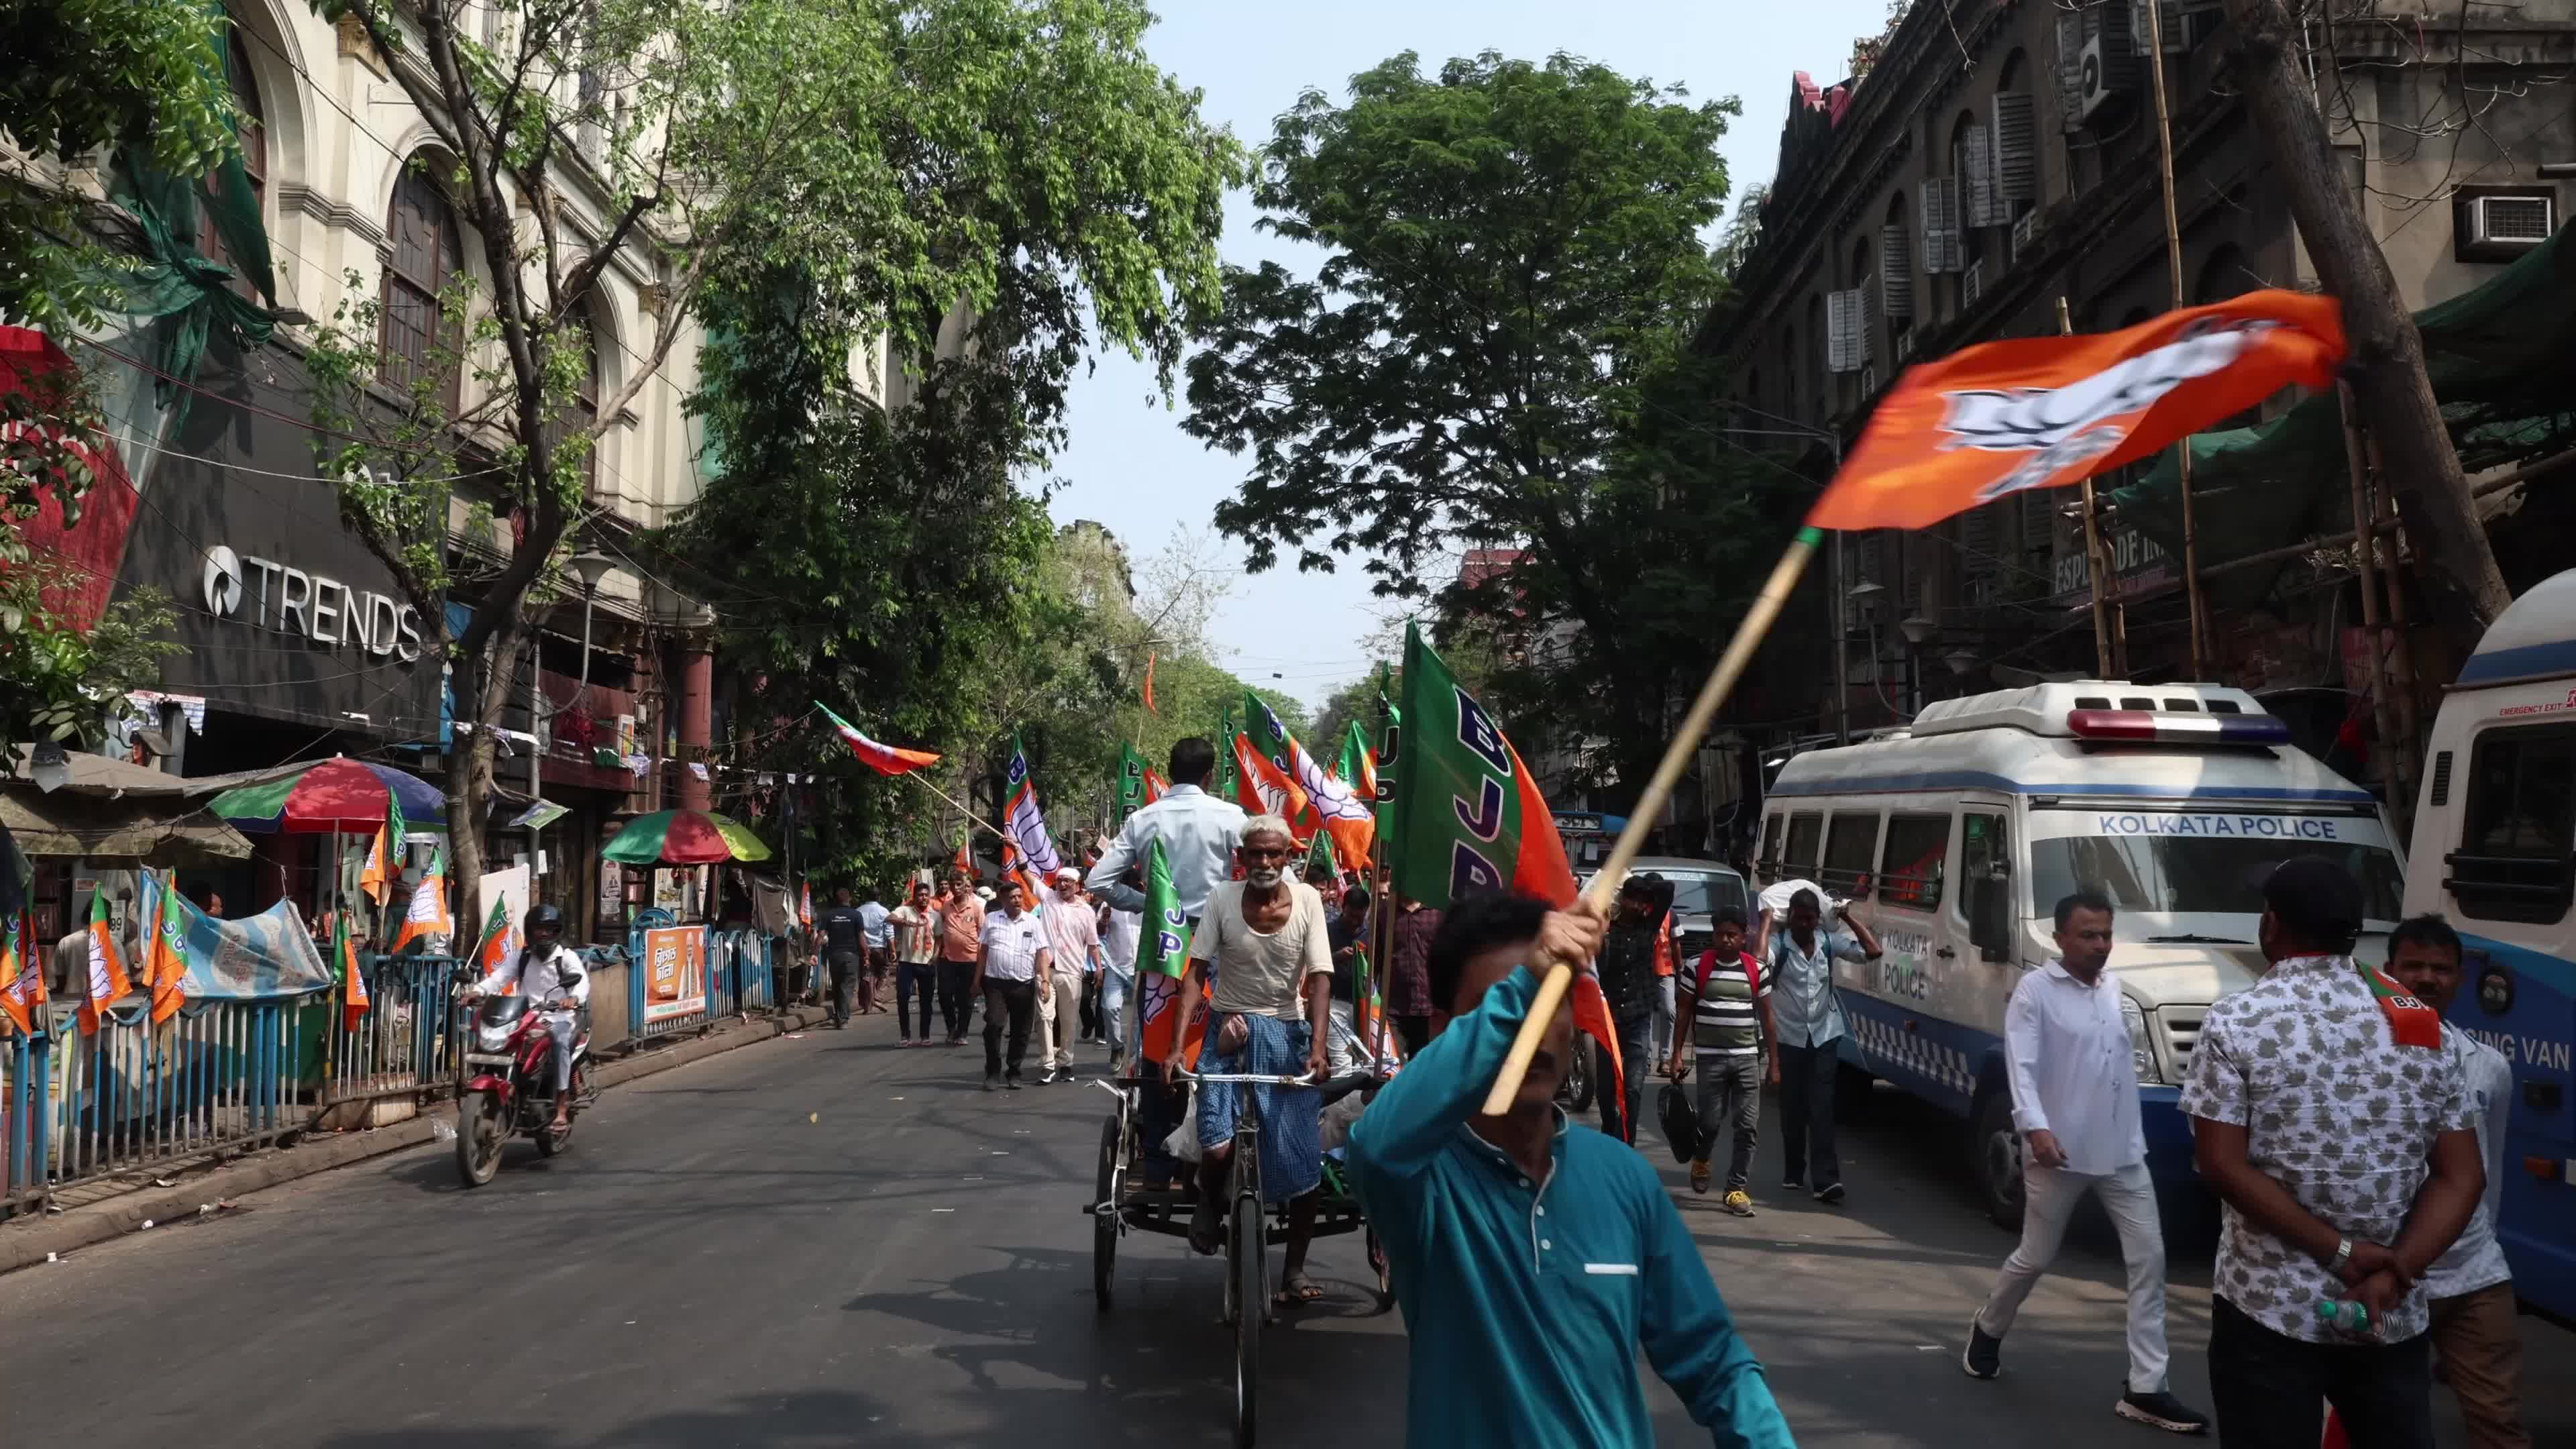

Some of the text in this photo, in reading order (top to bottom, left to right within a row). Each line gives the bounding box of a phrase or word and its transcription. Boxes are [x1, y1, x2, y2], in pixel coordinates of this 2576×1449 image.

[2055, 530, 2138, 594] ESPLDE
[243, 556, 421, 661] TRENDS
[2500, 702, 2563, 716] EMERGENCY EXIT
[1448, 683, 1512, 901] BJP
[2099, 815, 2337, 839] KOLKATA POLICE
[1886, 928, 1927, 956] KOLKATA
[1884, 963, 1925, 1001] POLICE
[2390, 995, 2430, 1012] BJ
[2522, 1037, 2570, 1072] VAN
